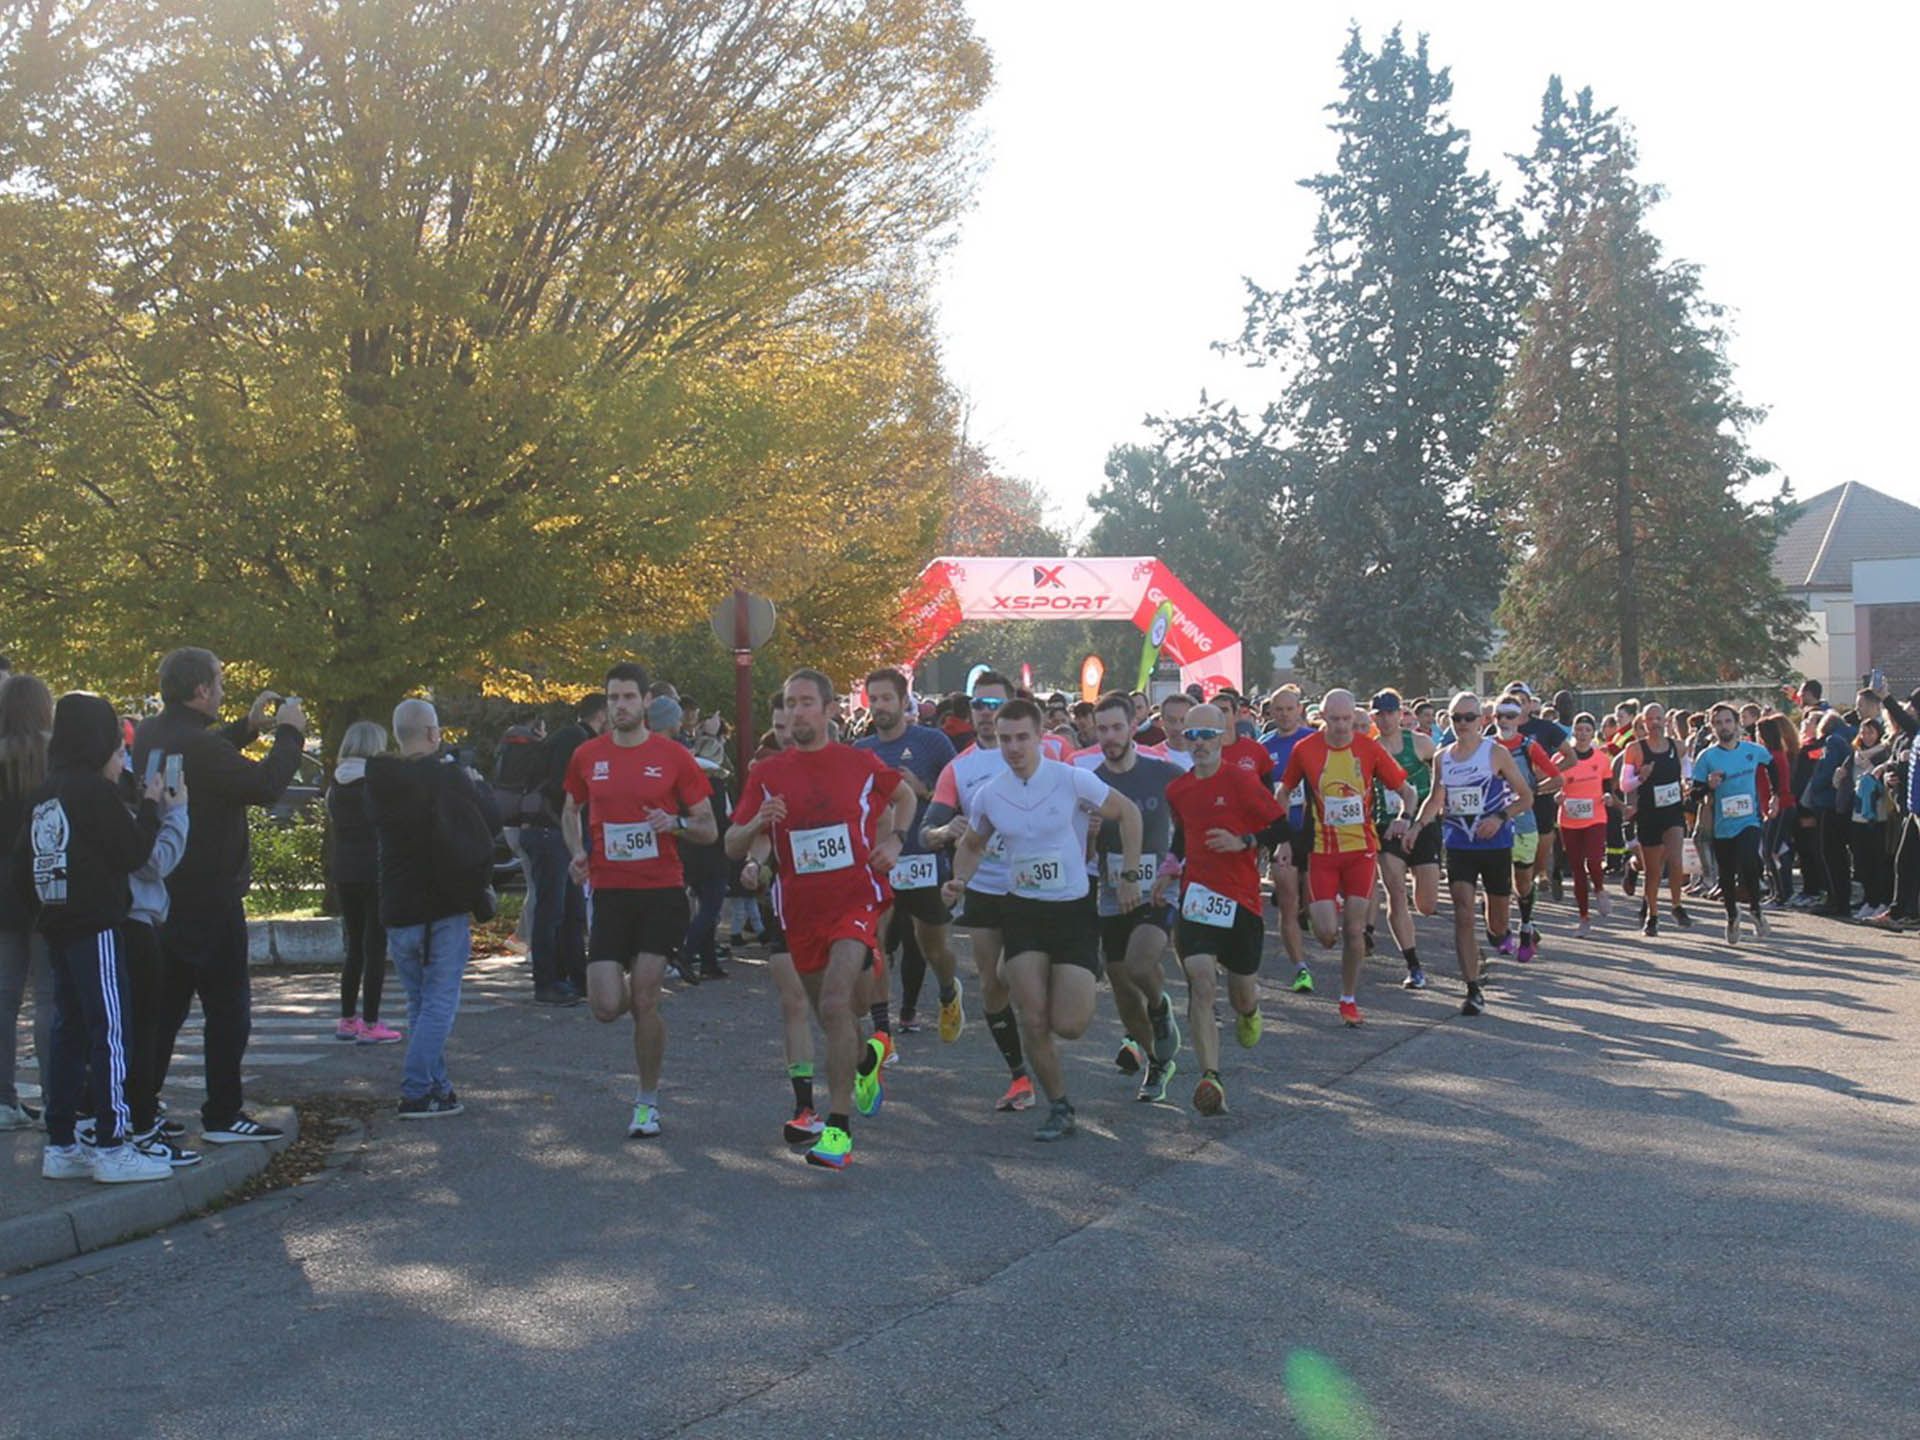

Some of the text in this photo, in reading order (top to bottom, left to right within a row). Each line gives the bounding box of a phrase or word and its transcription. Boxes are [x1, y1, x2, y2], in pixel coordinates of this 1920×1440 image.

[992, 595, 1111, 610] XSPORT
[1461, 793, 1480, 807] 578
[626, 831, 652, 850] 564
[817, 836, 846, 858] 584
[910, 863, 933, 879] 947
[1033, 862, 1058, 880] 367
[1206, 895, 1233, 917] 355
